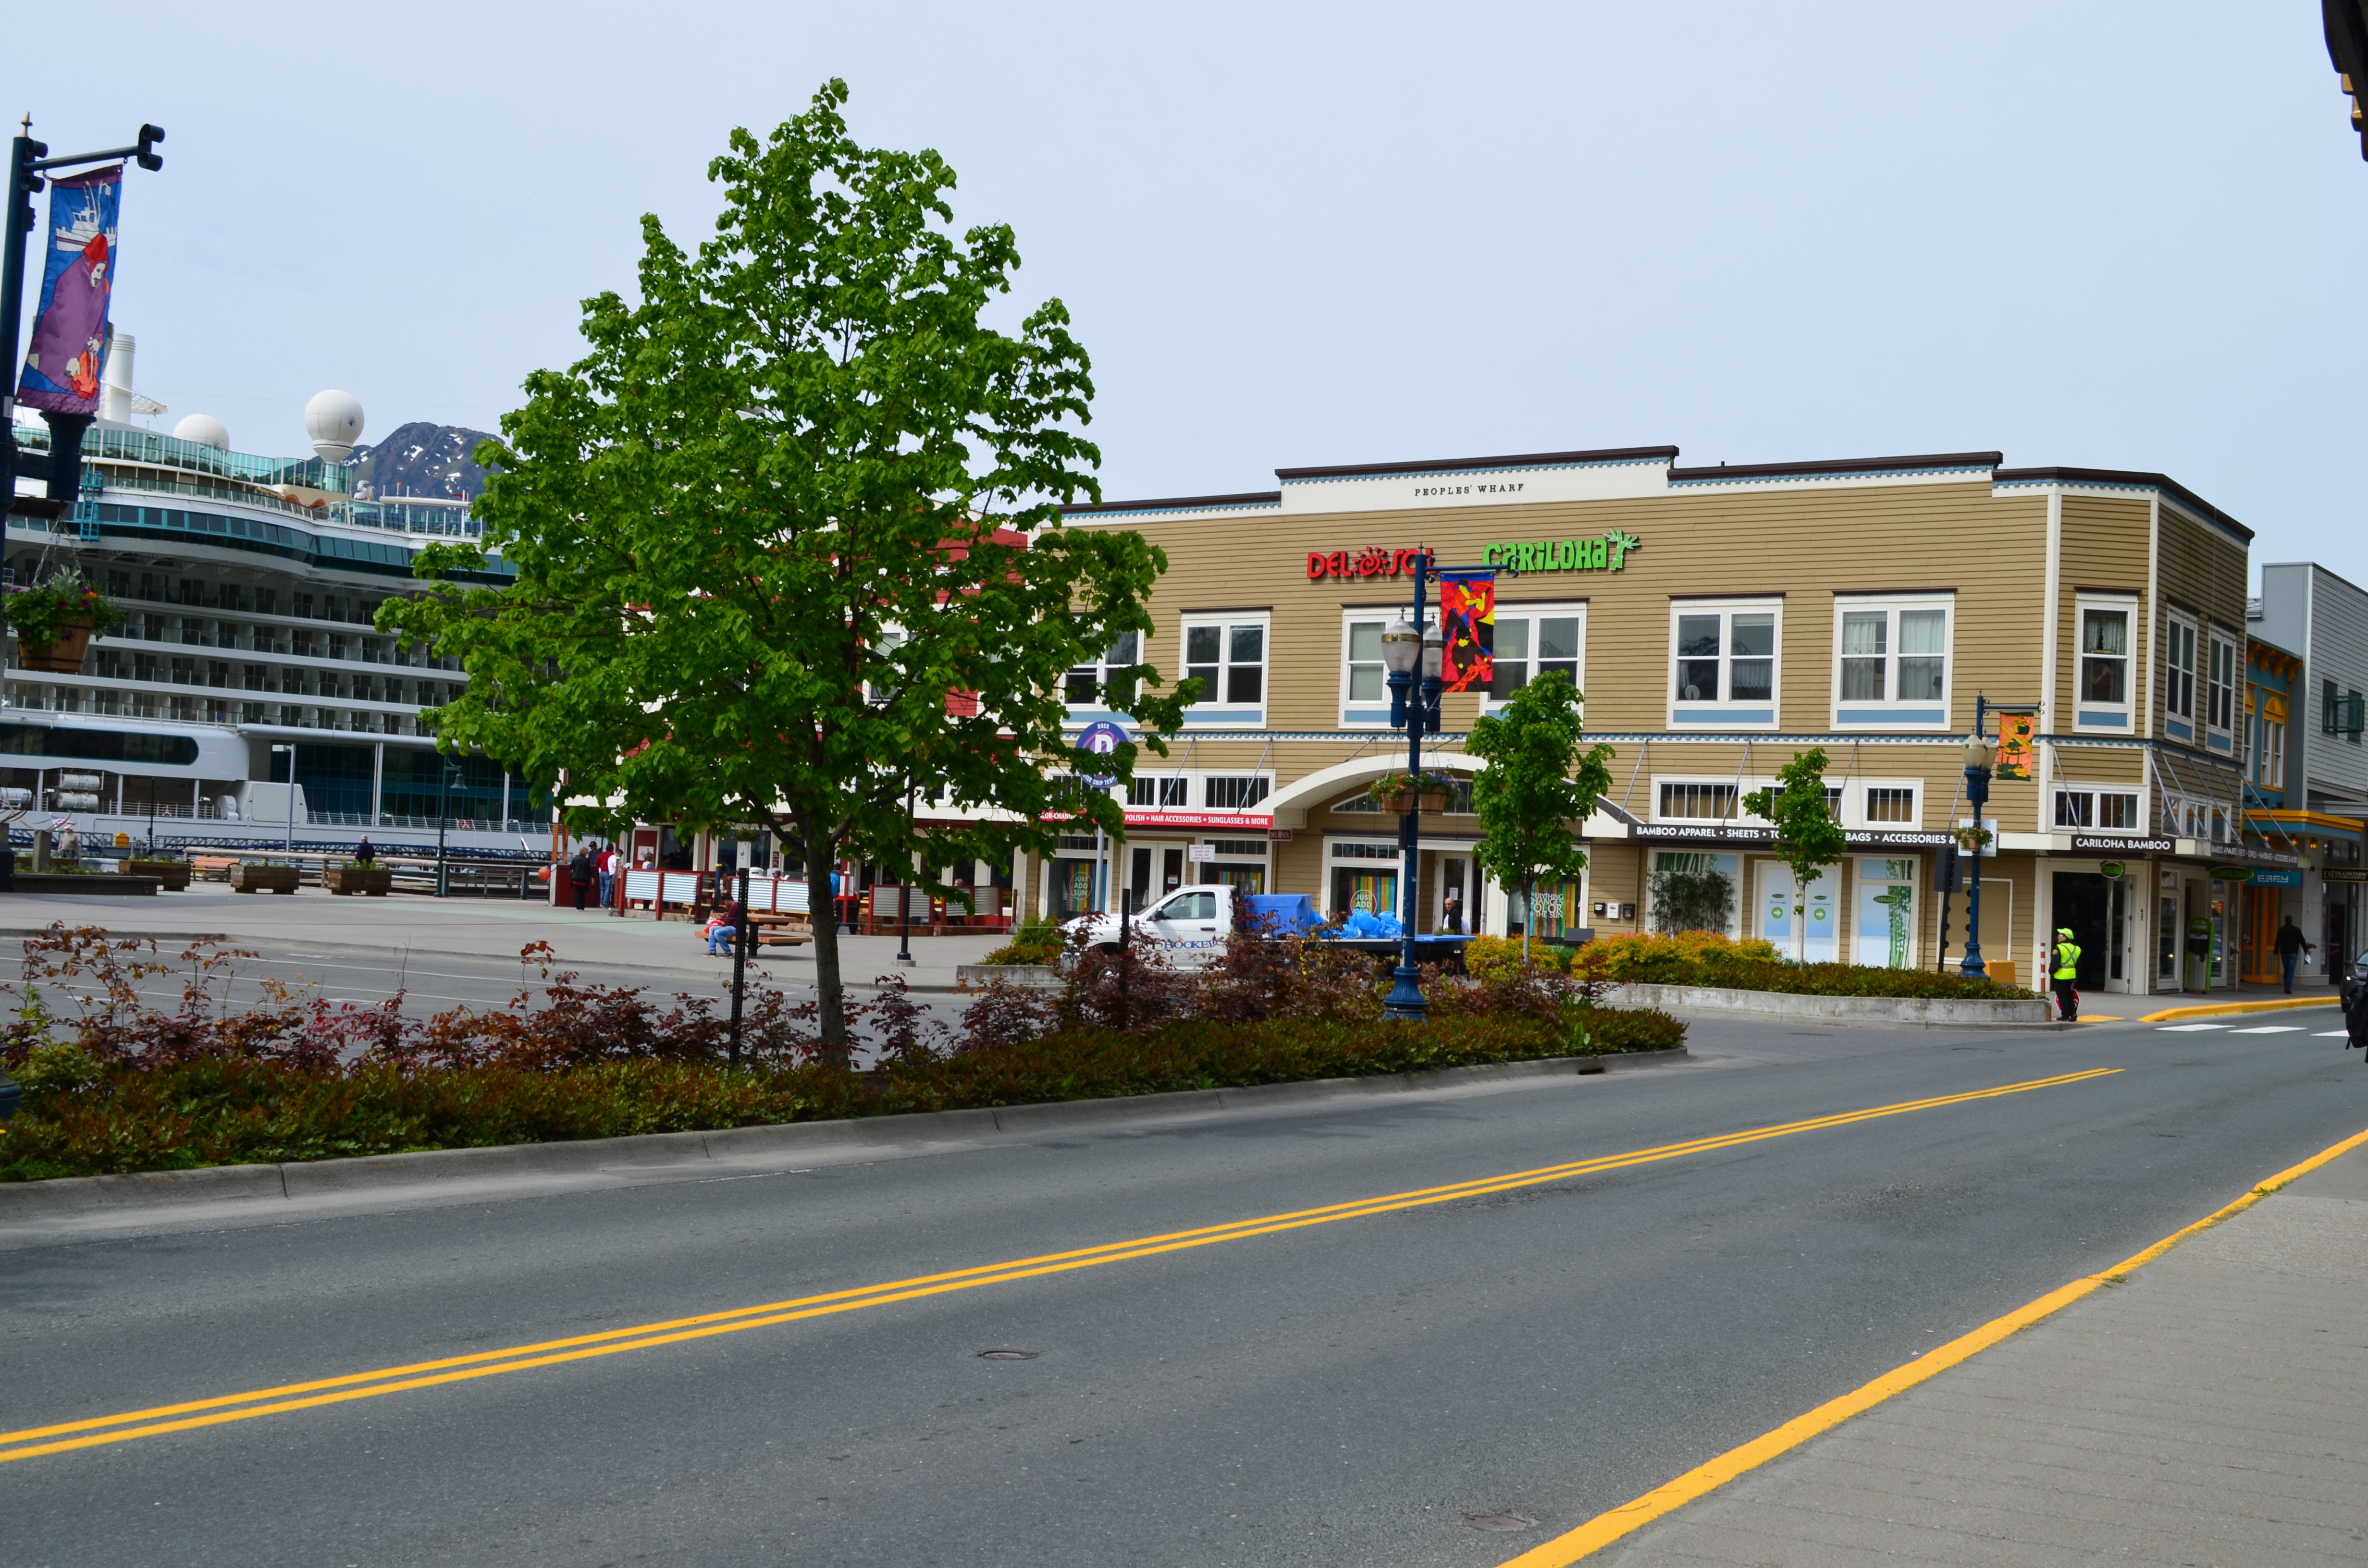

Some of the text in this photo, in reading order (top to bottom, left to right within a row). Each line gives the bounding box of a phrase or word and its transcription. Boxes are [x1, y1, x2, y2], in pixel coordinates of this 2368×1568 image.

[1415, 483, 1524, 496] PEOPLES' WHARF
[1307, 551, 1353, 578] DEL
[1208, 817, 1244, 825] SUNGLASSES
[1637, 826, 1677, 836] BAMBOO
[1678, 828, 1716, 837] APPAREL
[1727, 830, 1759, 838] SHEETS
[1882, 833, 1947, 844] ACCESSORIES
[1949, 834, 1957, 844] &
[2076, 838, 2171, 850] CARILOHA BAMBOO
[1534, 903, 1563, 913] OLOR
[1164, 939, 1218, 949] HOOKED
